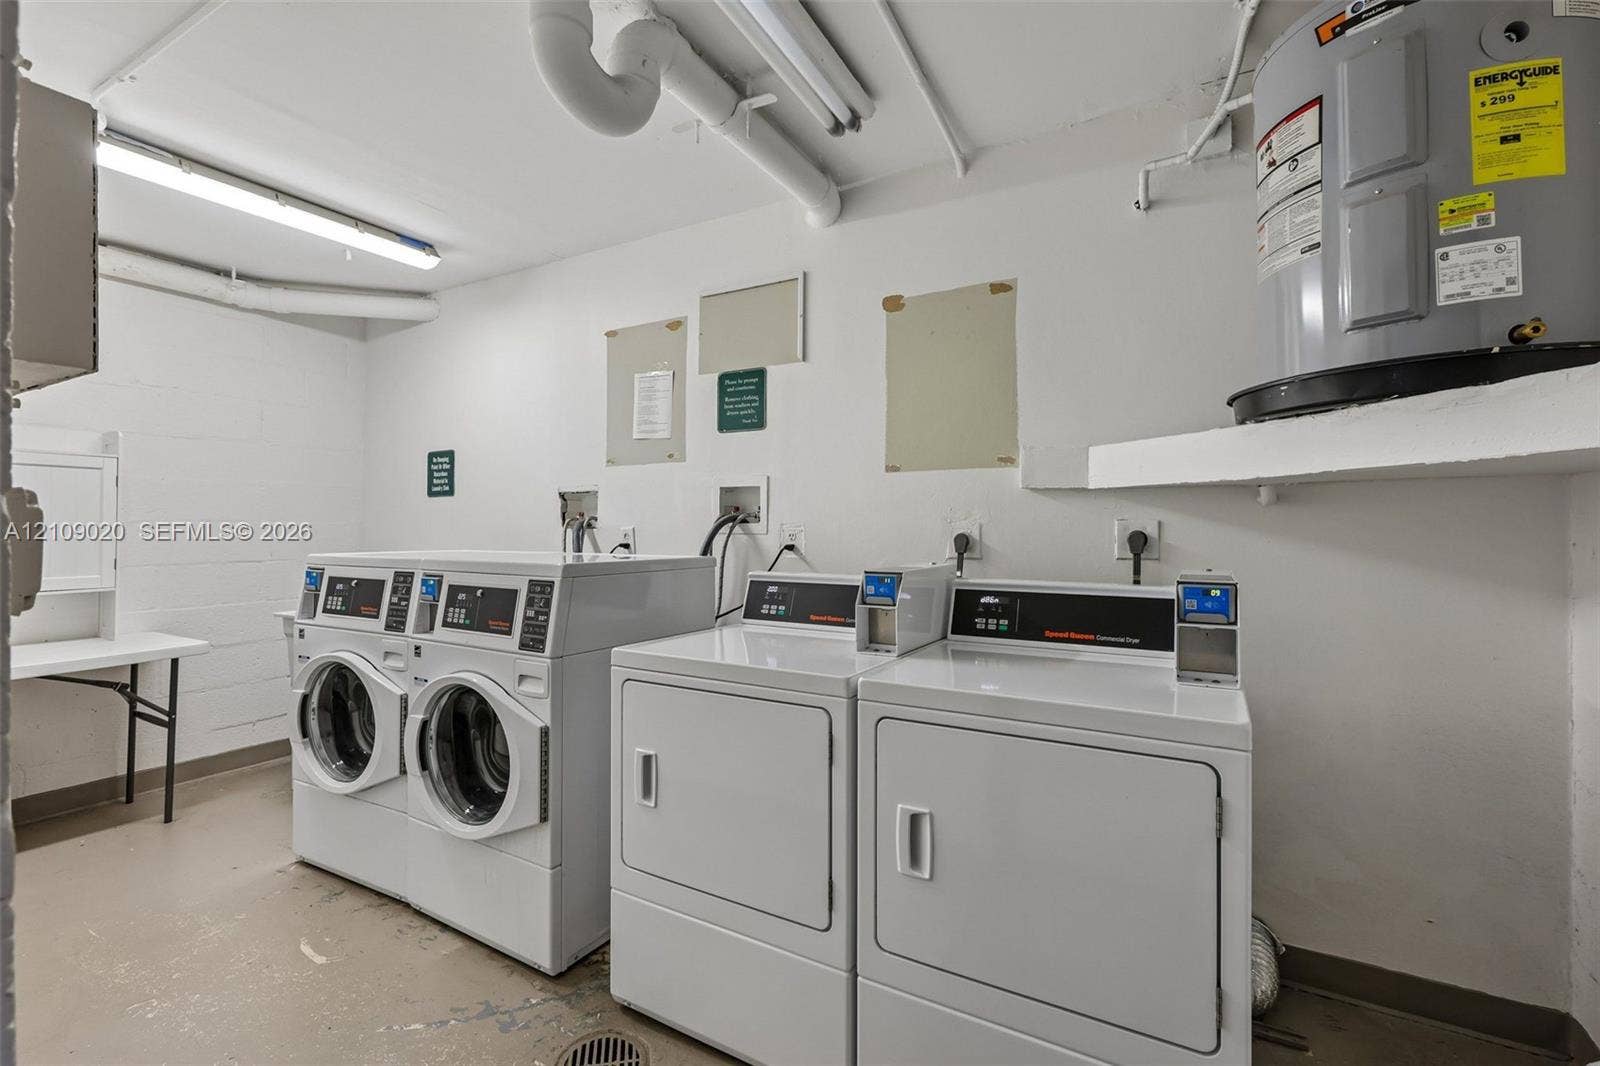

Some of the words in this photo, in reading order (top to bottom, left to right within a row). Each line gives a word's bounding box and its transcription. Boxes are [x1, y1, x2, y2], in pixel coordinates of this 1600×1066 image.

[1474, 65, 1561, 88] ENERGYGUIDE
[1490, 94, 1516, 106] 299
[1044, 630, 1069, 639] Speed
[1069, 632, 1095, 640] Queen
